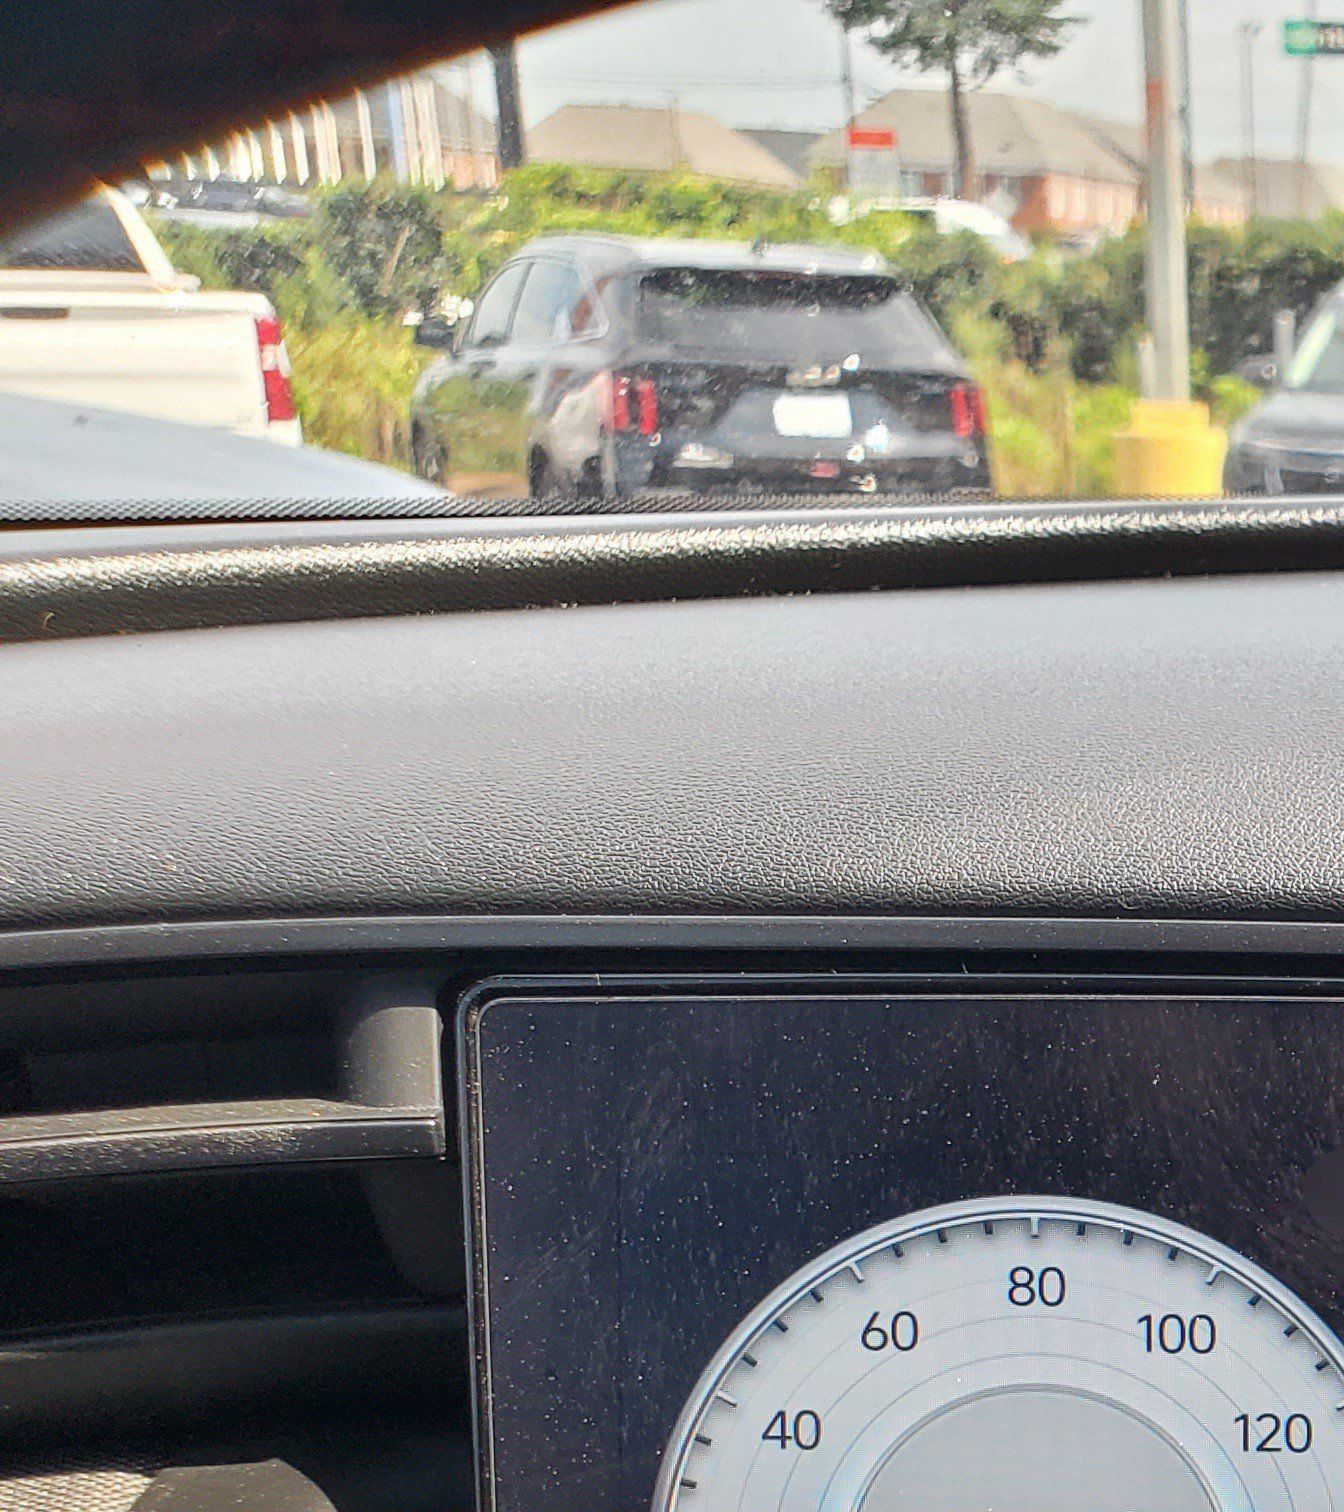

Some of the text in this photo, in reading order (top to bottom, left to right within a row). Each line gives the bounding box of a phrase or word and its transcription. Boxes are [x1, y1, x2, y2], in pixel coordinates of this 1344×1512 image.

[1007, 1265, 1066, 1308] 80
[860, 1310, 920, 1353] 60
[1137, 1312, 1217, 1355] 100
[761, 1409, 822, 1451] 40
[1234, 1412, 1313, 1454] 120
